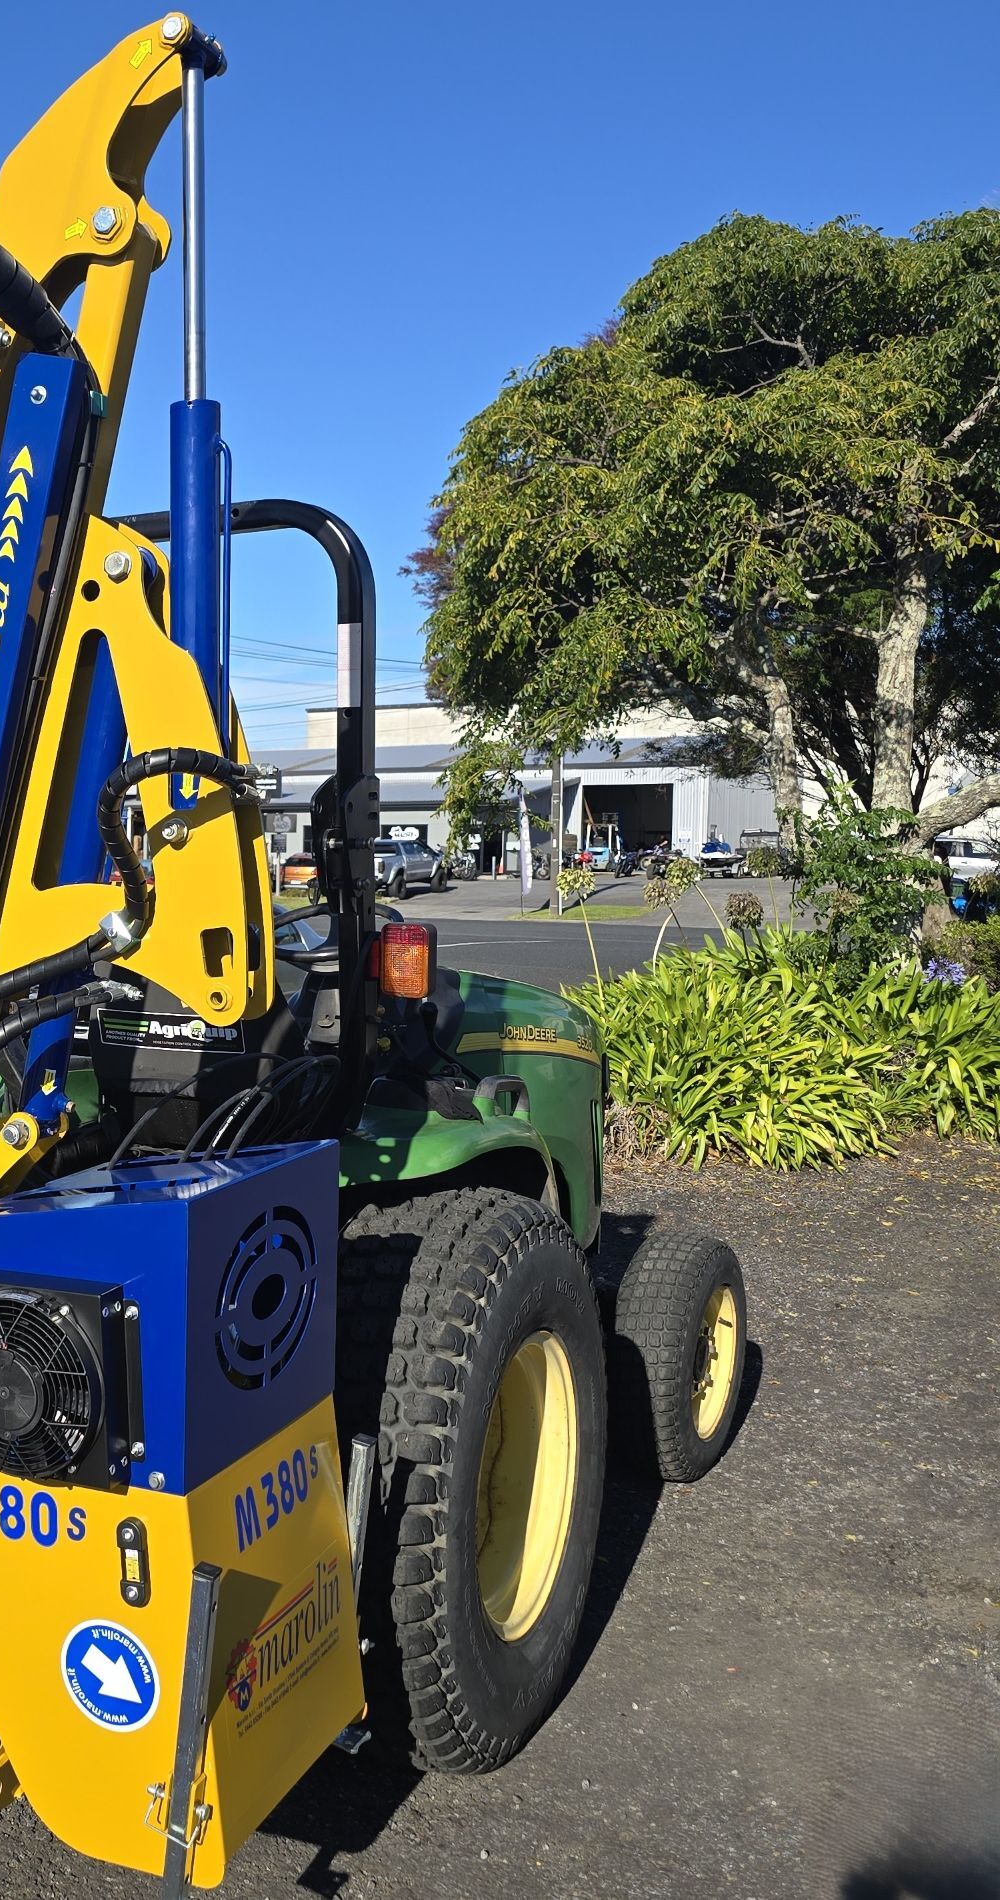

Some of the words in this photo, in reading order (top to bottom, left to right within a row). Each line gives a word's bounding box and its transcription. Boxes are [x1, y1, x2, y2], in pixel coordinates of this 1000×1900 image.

[148, 1019, 238, 1043] AgriQuip
[527, 1024, 557, 1043] DEERE
[234, 1486, 261, 1553] M
[261, 1449, 308, 1530] 380
[258, 1561, 341, 1688] marolin
[91, 1628, 152, 1684] www.marolin.it
[67, 1667, 129, 1724] www.marolin.it
